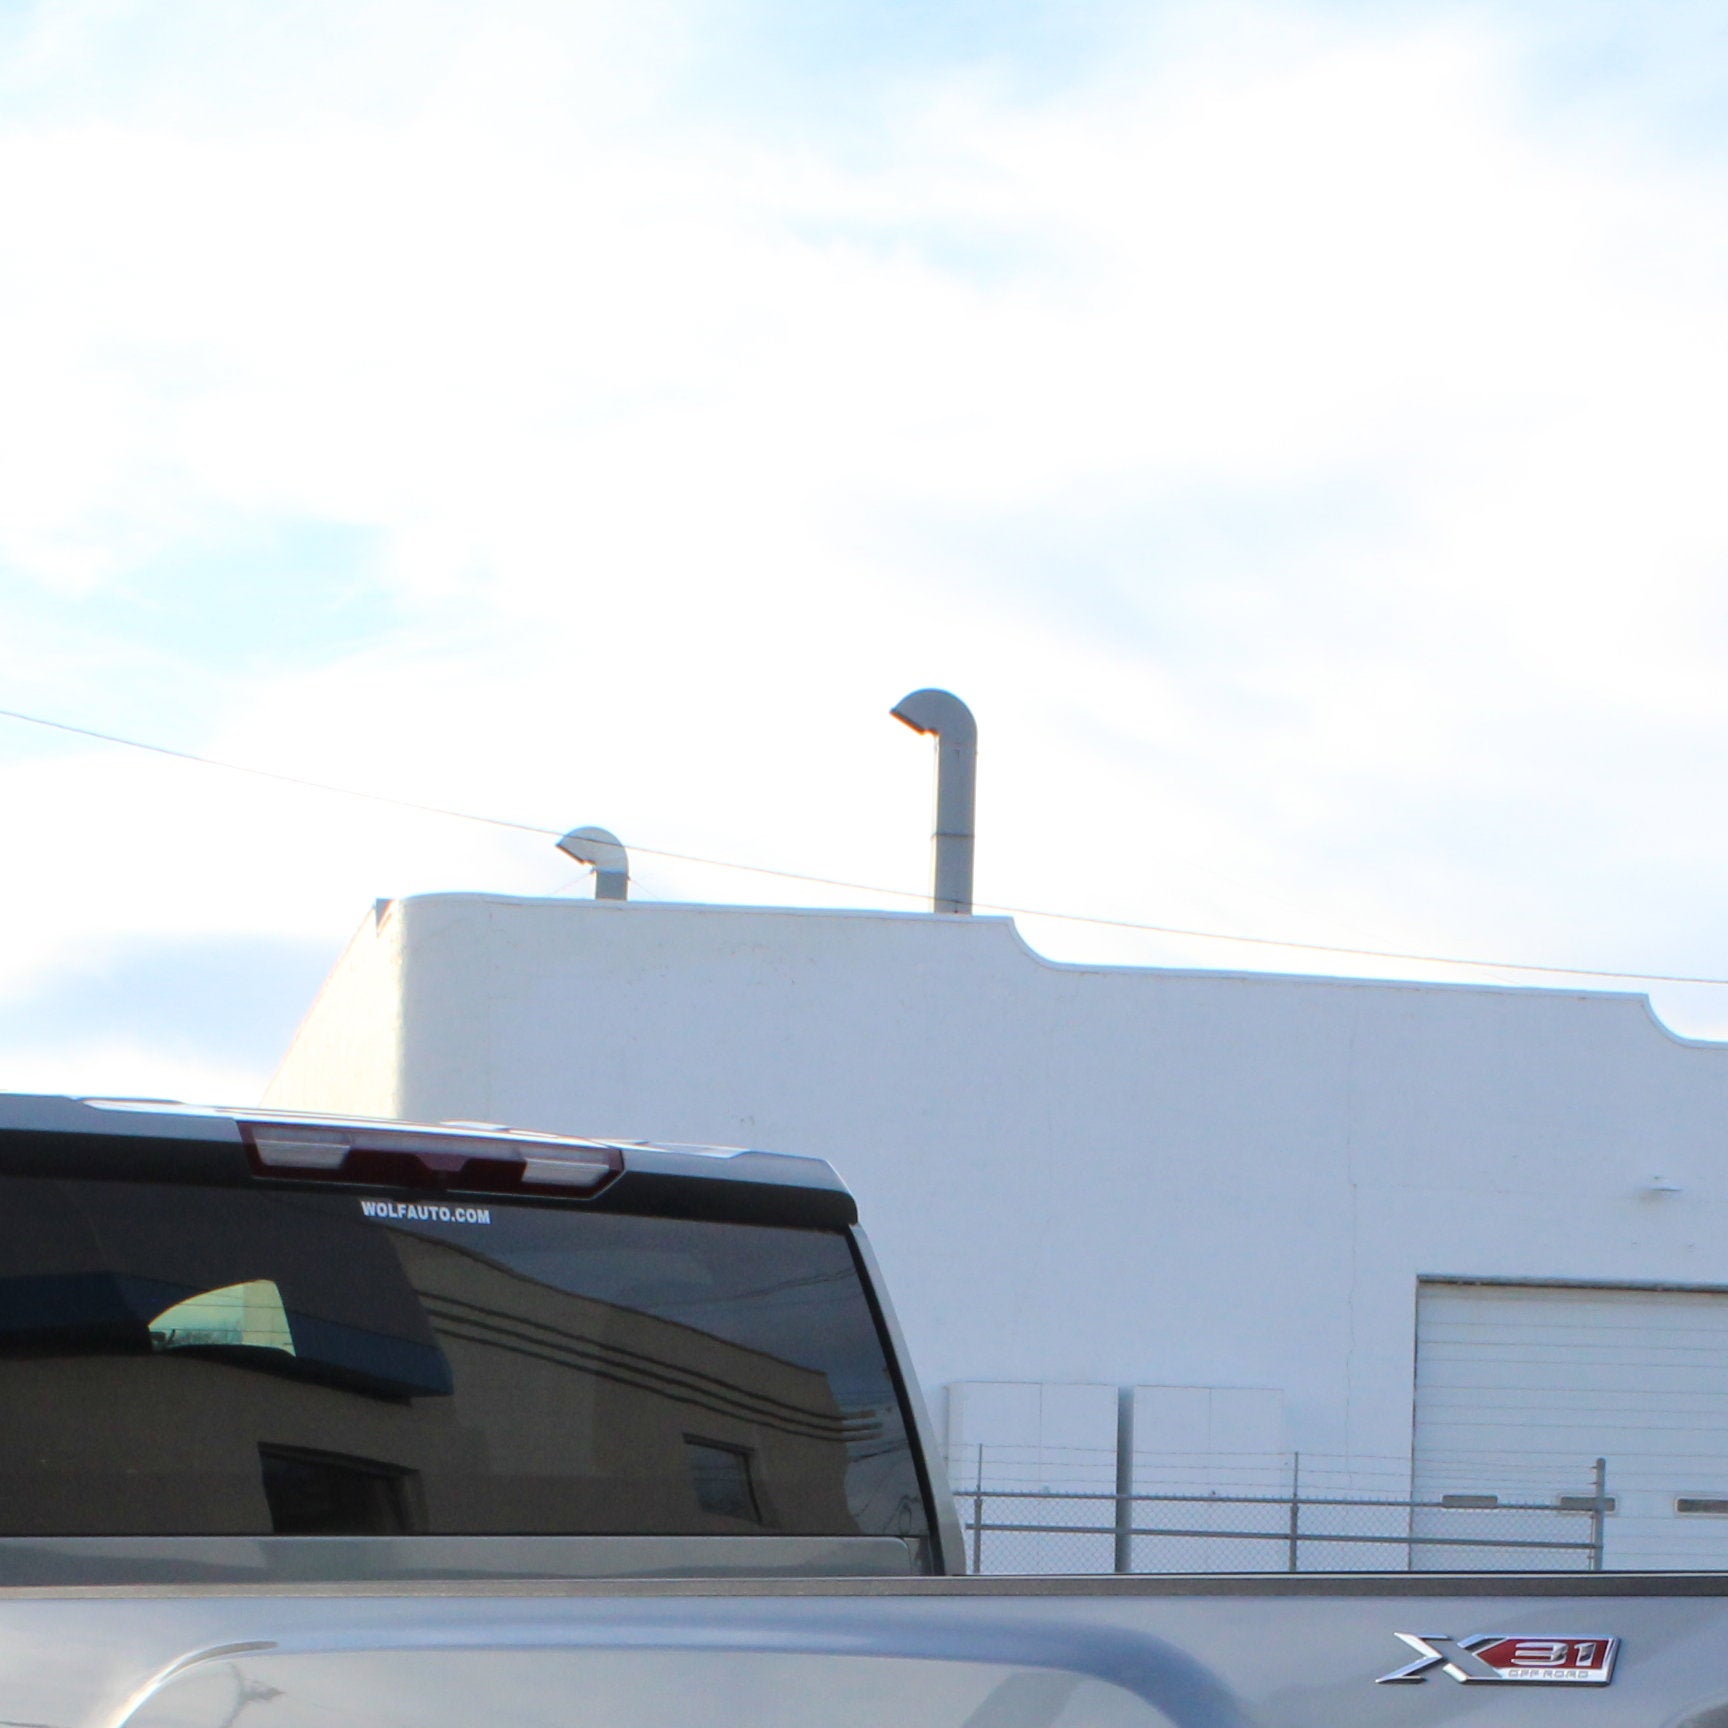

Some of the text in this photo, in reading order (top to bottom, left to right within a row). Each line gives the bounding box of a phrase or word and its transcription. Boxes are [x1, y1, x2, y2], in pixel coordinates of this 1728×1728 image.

[361, 1201, 490, 1224] WOLFAUTO.COM
[1508, 1668, 1589, 1679] OFF ROAD
